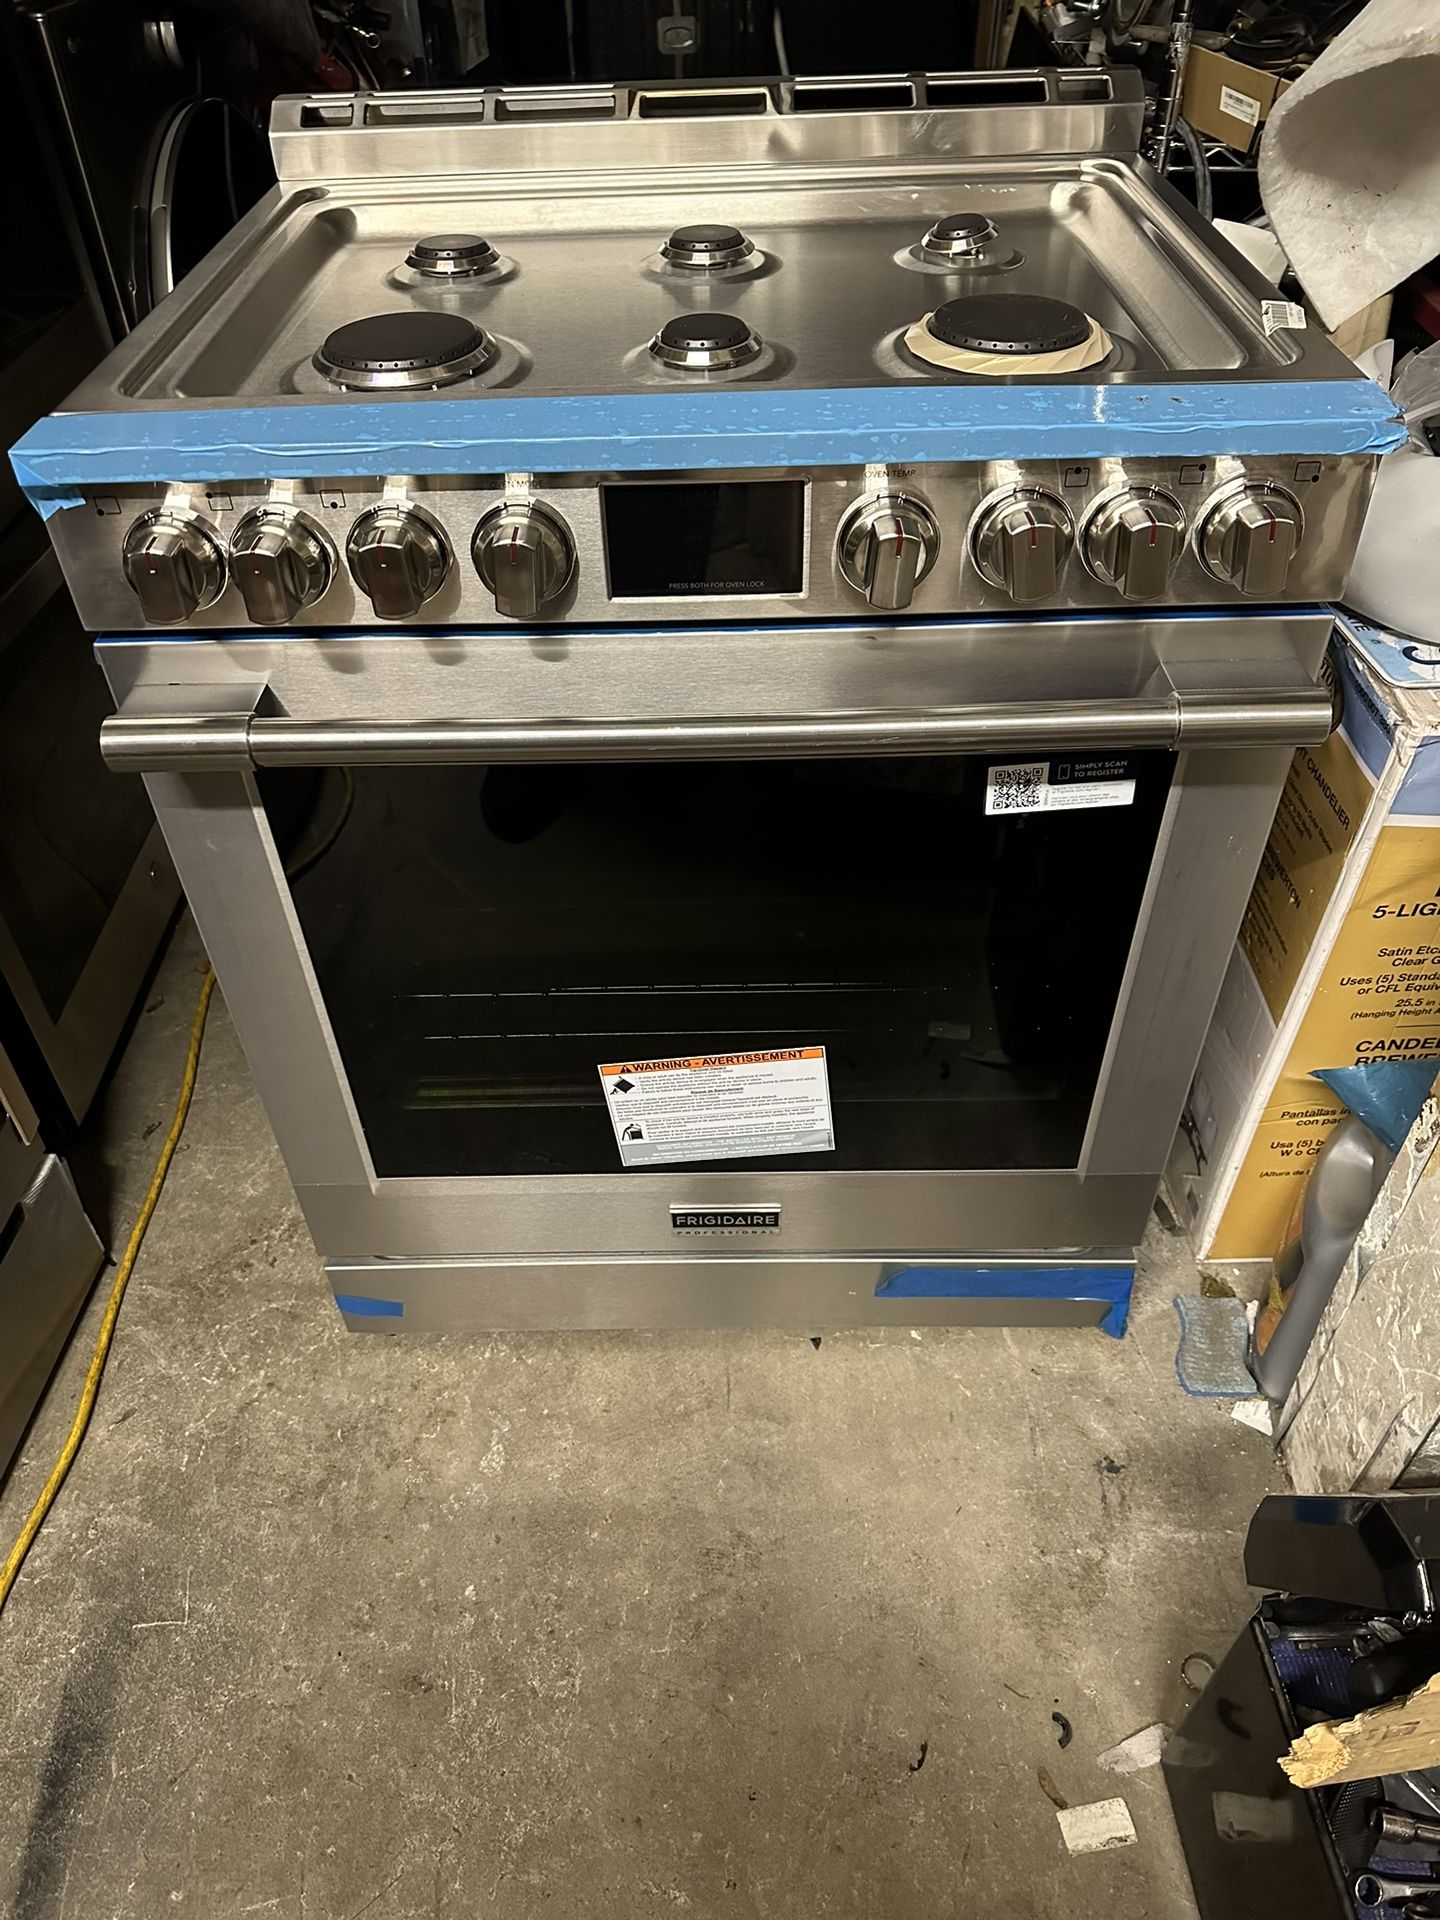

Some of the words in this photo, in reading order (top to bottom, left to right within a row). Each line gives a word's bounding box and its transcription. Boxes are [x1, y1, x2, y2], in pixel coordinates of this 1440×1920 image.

[864, 469, 889, 478] OVEN
[892, 469, 916, 477] TEMP
[1075, 762, 1102, 770] SIMPLY
[1104, 760, 1128, 768] SCAN
[1075, 770, 1086, 778] TO
[1087, 768, 1125, 777] REGISTER
[1306, 757, 1350, 830] CHANDELIER
[1377, 947, 1413, 958] Satin
[1416, 945, 1440, 956] Etc
[1391, 957, 1428, 967] Clear
[1340, 977, 1373, 986] Uses
[1376, 974, 1394, 986] (5)
[1357, 987, 1372, 995] or
[1375, 984, 1401, 994] CFL
[1395, 998, 1424, 1008] 25.5
[1350, 1009, 1396, 1020] (Hanging
[1399, 1007, 1432, 1017] Height
[632, 1059, 691, 1072] WARNING
[702, 1050, 805, 1066] AVERTISSEMENT
[1280, 1108, 1337, 1119] Pantallas
[1270, 1141, 1293, 1150] Usa
[1296, 1140, 1313, 1149] (5)
[1280, 1149, 1293, 1157] W
[1259, 1170, 1291, 1179] (Altura
[676, 1215, 775, 1226] FRIGIDAIRE
